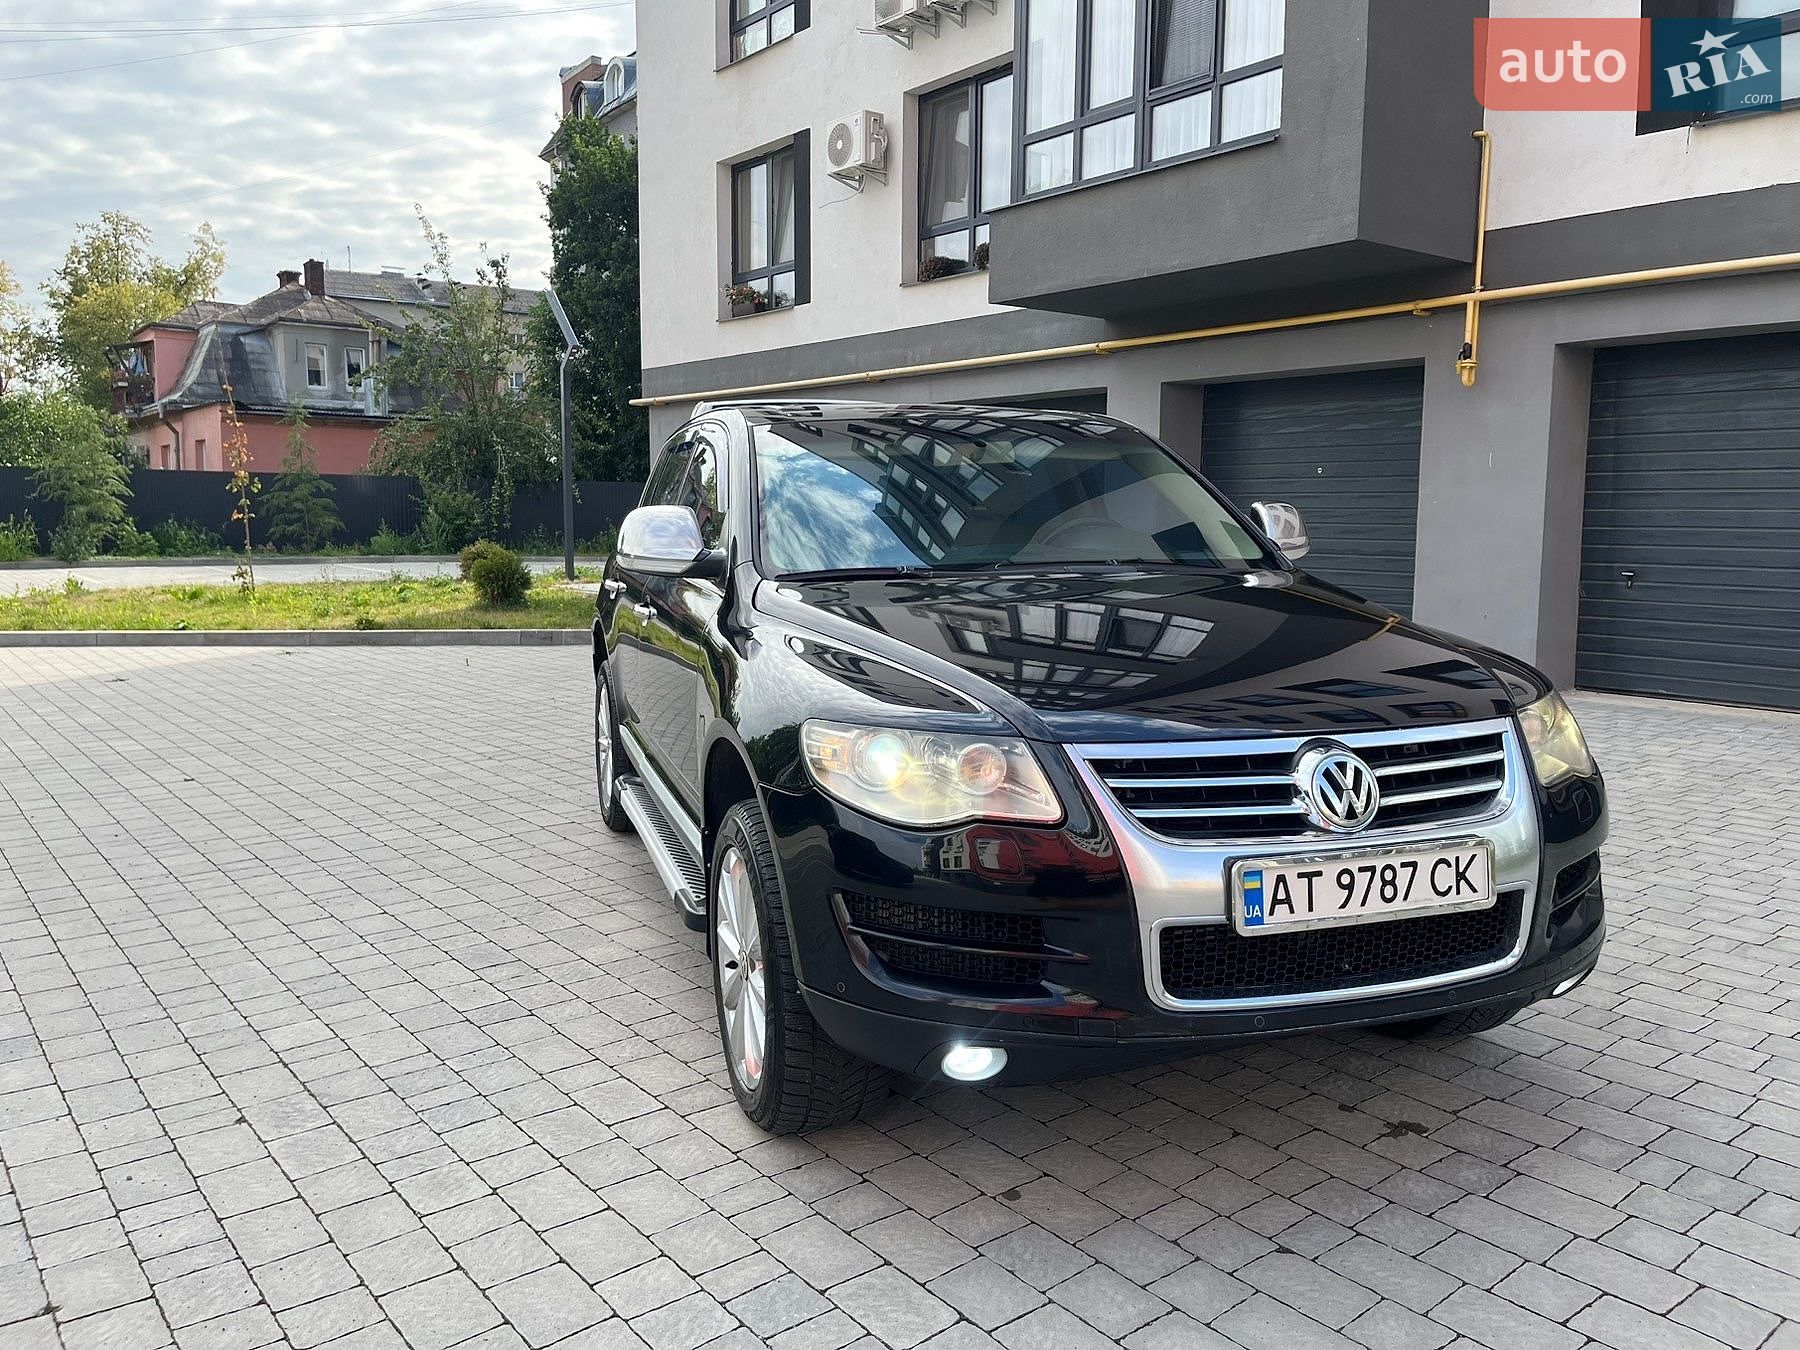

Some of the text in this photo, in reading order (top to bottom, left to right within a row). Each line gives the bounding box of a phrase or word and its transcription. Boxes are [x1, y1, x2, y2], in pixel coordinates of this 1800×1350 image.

[1268, 853, 1478, 917] AT 9787 CK
[1244, 905, 1262, 919] UA
